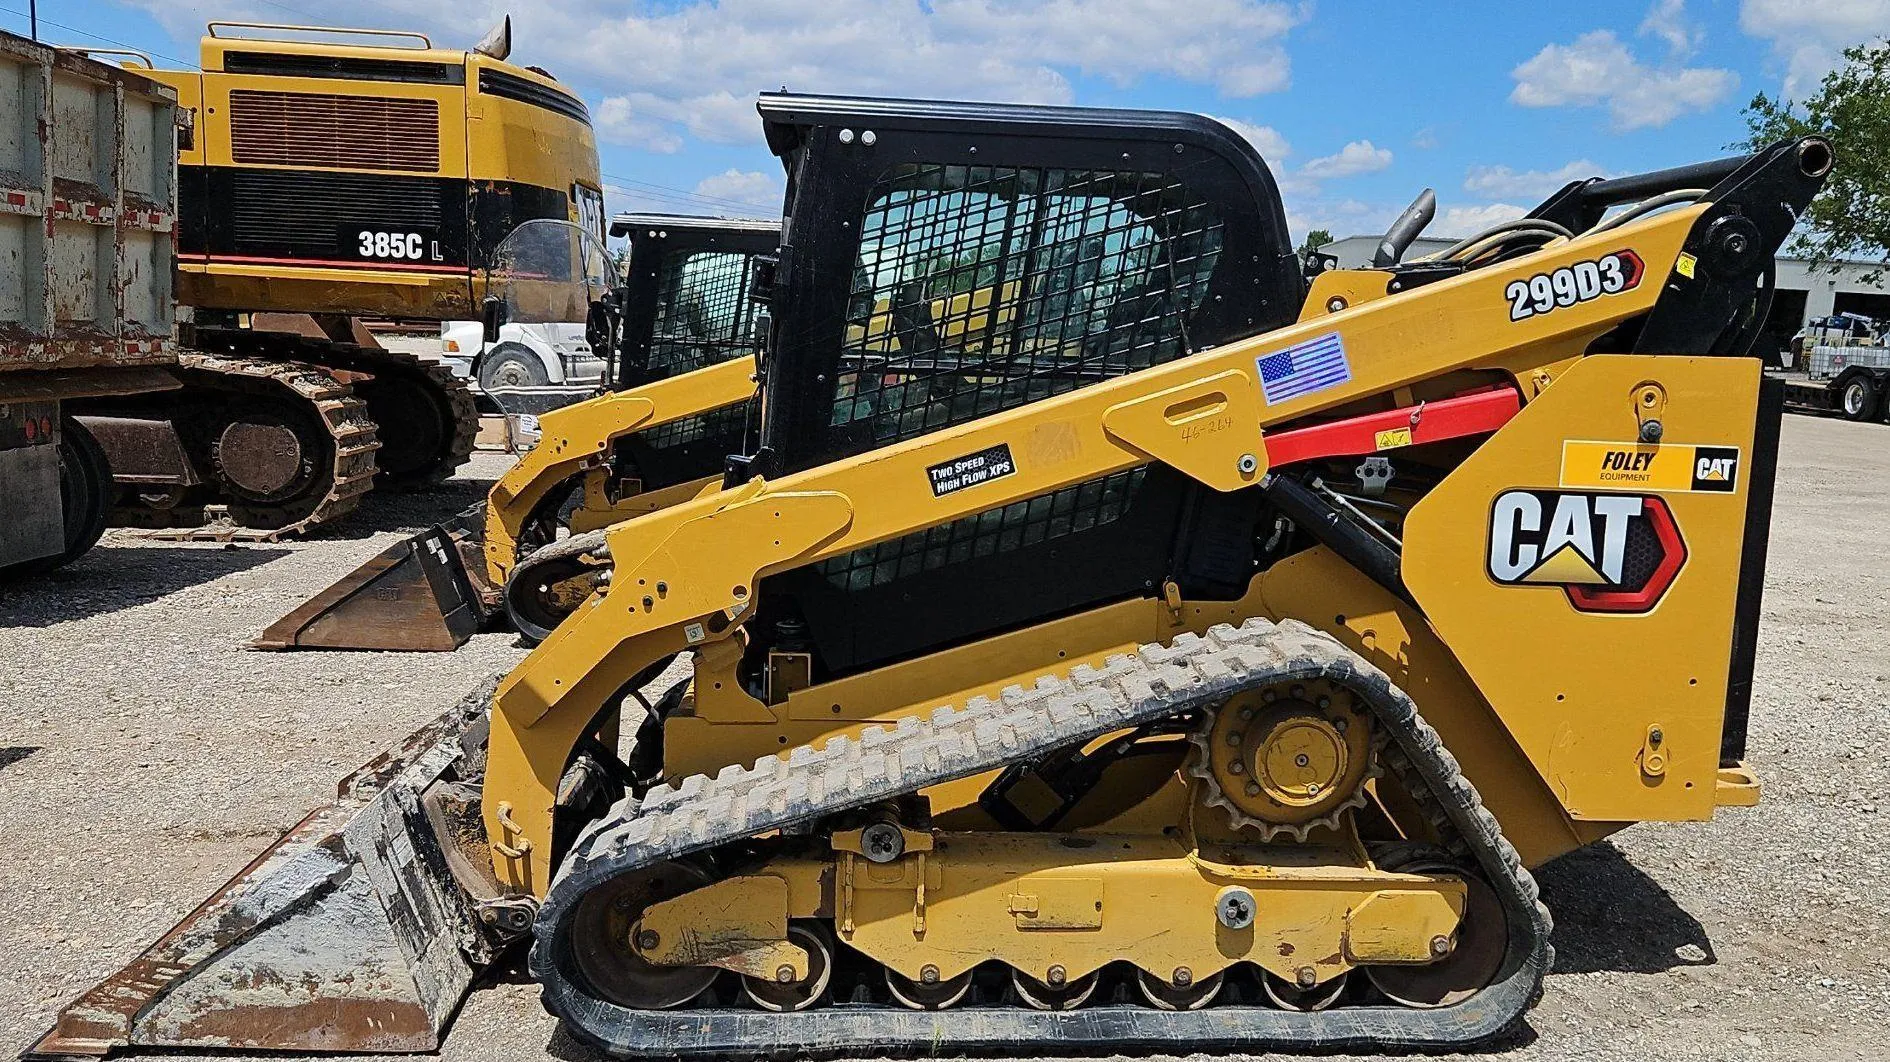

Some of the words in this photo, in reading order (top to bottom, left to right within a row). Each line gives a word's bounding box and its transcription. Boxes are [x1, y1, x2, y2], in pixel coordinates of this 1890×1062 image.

[358, 231, 423, 260] 385C
[431, 240, 444, 261] L
[1506, 255, 1625, 320] 299D3
[989, 461, 1010, 476] XPS
[1601, 451, 1657, 472] FOLEY
[1696, 457, 1734, 481] CAT
[1599, 472, 1651, 482] EQUIPMENT
[1490, 491, 1643, 585] CAT
